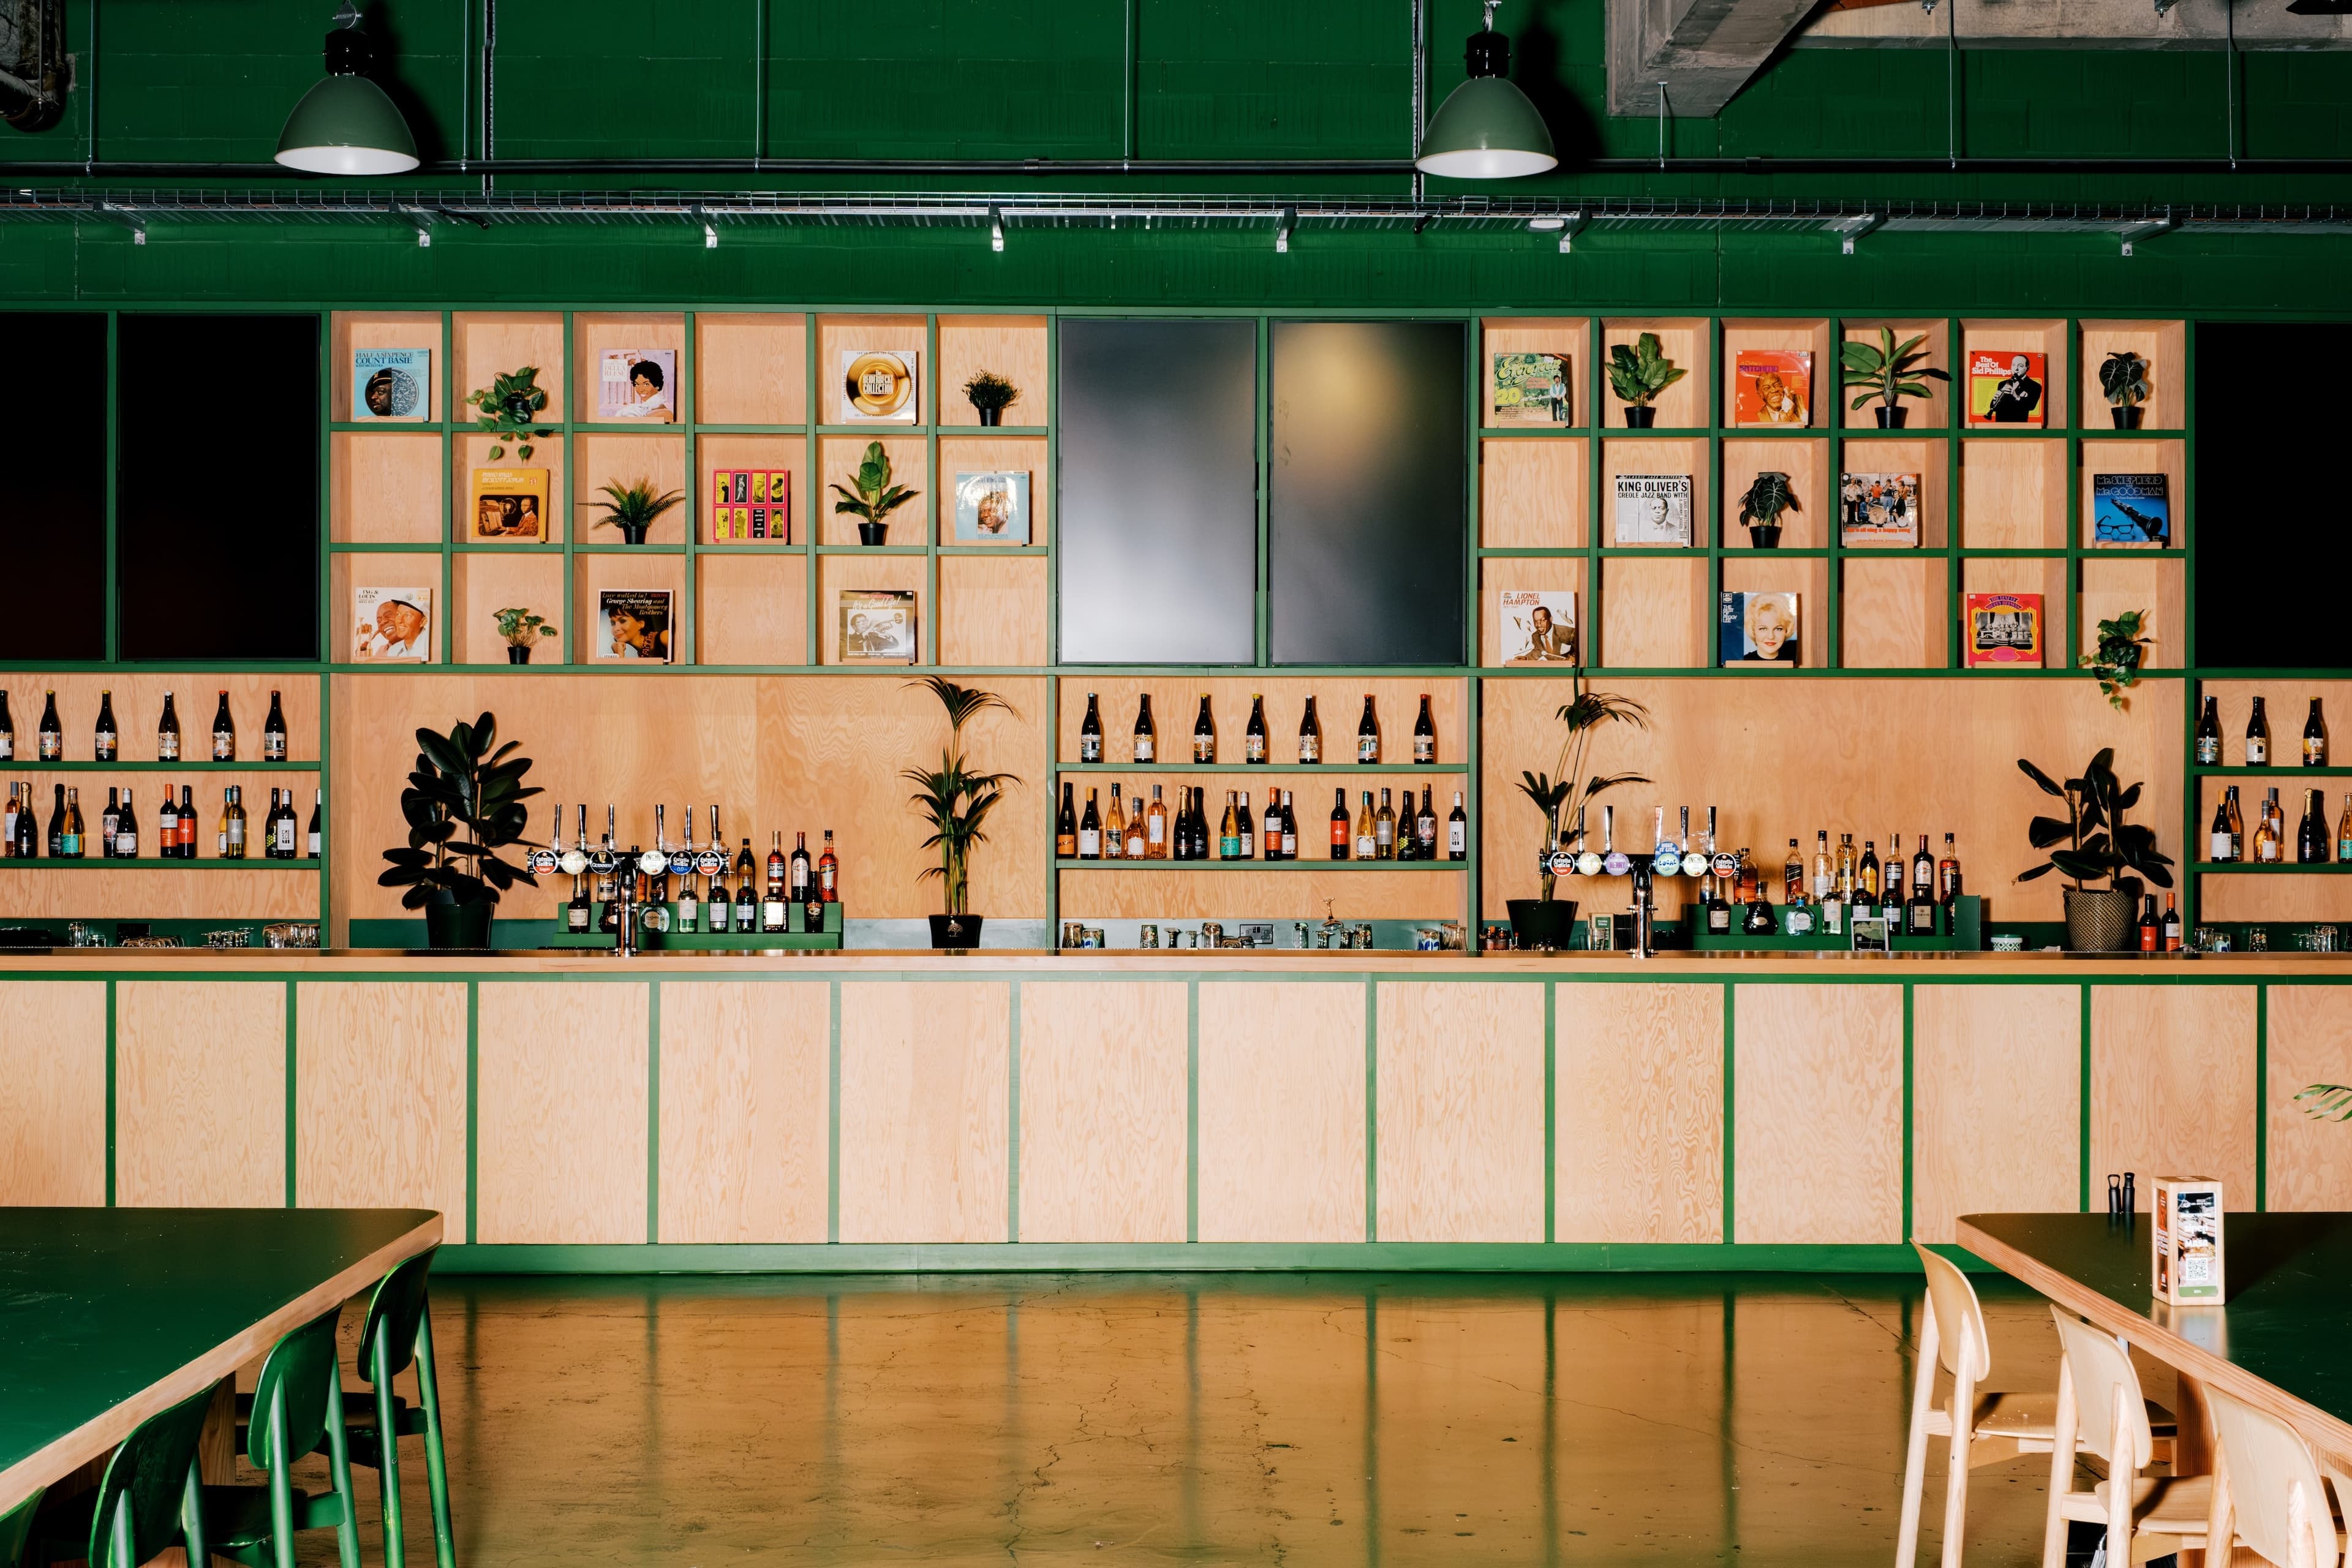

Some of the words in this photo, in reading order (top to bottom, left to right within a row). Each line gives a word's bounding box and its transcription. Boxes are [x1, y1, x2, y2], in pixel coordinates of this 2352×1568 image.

[1496, 356, 1562, 387] Evergreen
[1985, 368, 2011, 377] Phillips
[863, 383, 893, 394] COLLECTION
[1494, 387, 1521, 406] 20
[2111, 475, 2162, 484] SHEPHERD
[1618, 481, 1642, 492] KING
[1645, 480, 1687, 492] OLIVER'S
[2111, 487, 2163, 496] GOODMAN
[853, 600, 863, 610] It's
[869, 598, 884, 610] Good
[884, 595, 902, 610] Life!
